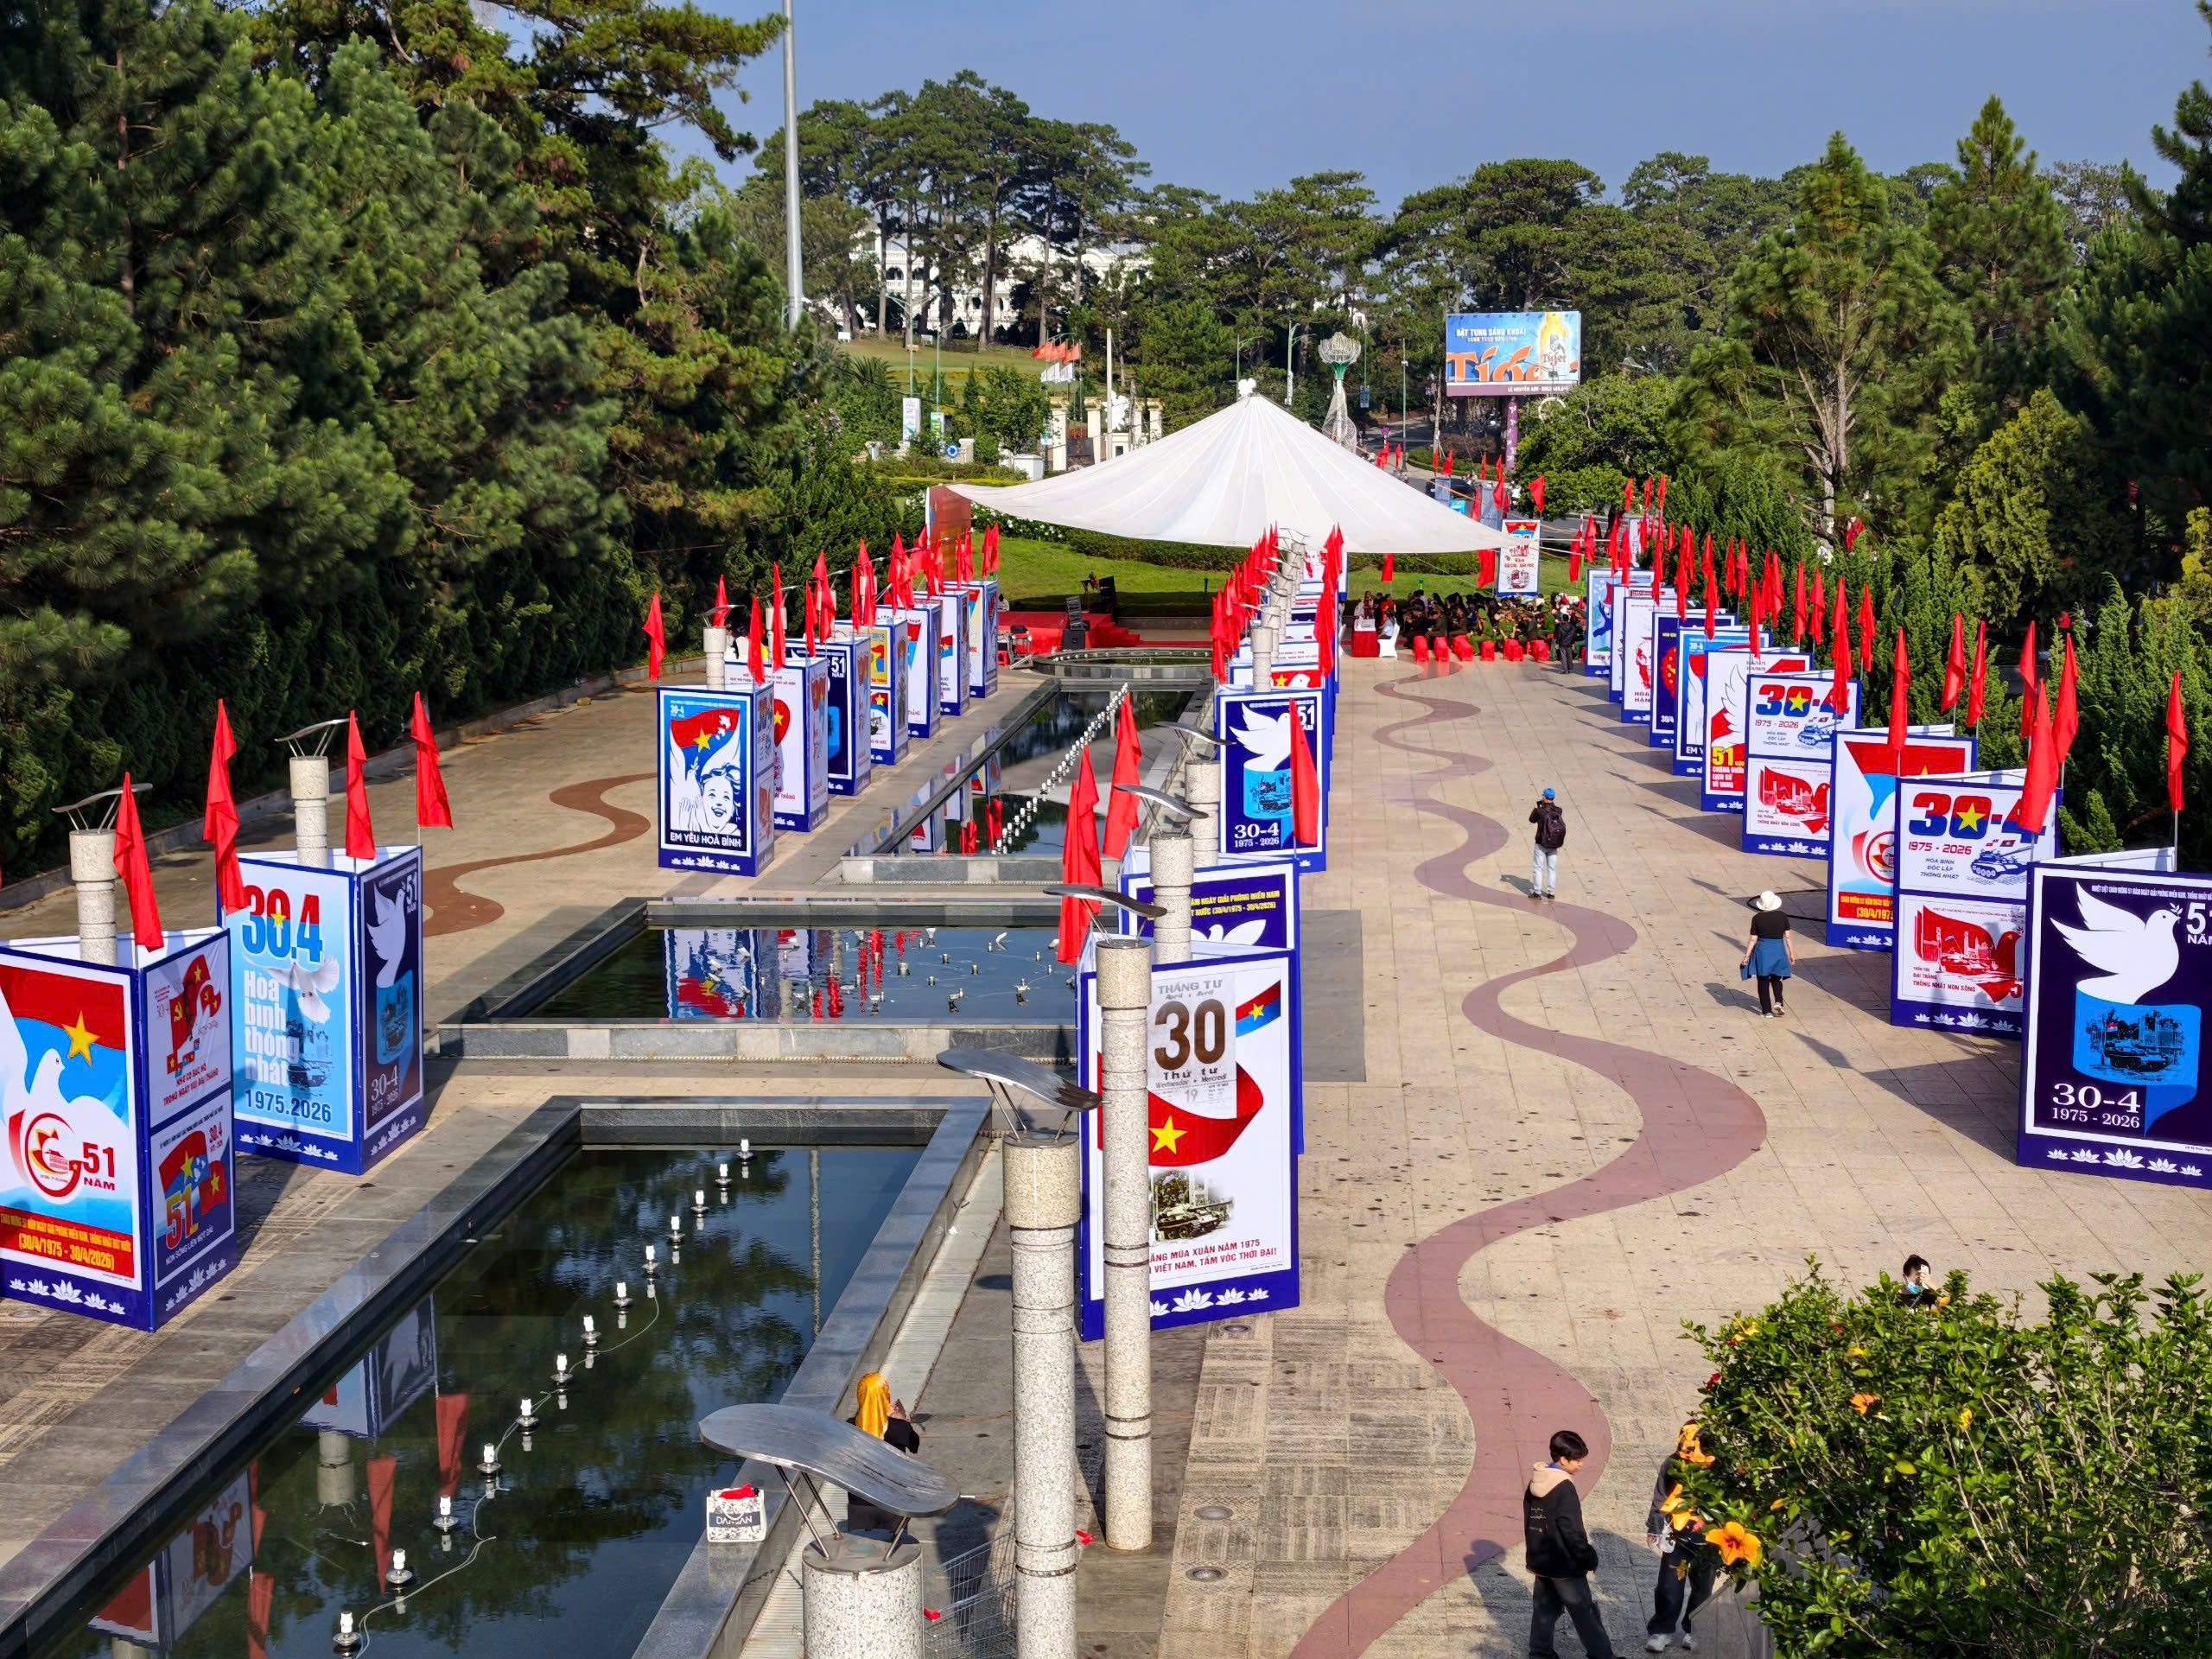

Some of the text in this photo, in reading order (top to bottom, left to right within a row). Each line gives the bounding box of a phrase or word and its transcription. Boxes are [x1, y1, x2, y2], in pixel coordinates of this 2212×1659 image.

[831, 656, 845, 673] 51
[1297, 704, 1315, 726] 51
[1712, 746, 1734, 766] 51
[670, 830, 741, 848] EM YÊU HOÀ BÌNH
[1234, 822, 1280, 839] 30-4
[1234, 839, 1254, 848] 1975
[1260, 837, 1280, 847] 2026
[1908, 841, 1933, 852] 1975
[1942, 843, 1973, 855] 2026
[241, 885, 323, 963] 30.4
[244, 969, 279, 1003] Hòa
[1157, 980, 1223, 994] THÁNG TƯ
[244, 996, 287, 1031] bình
[1154, 999, 1225, 1071] 30
[371, 1065, 398, 1102] 30-4
[1155, 1074, 1227, 1088] Wednesday Mercredi
[1164, 1067, 1217, 1080] Thứ tư
[245, 1089, 332, 1123] 1975.2026
[2052, 1083, 2141, 1114] 30-4
[2052, 1107, 2088, 1122] 1975
[2102, 1113, 2140, 1128] 2026
[82, 1141, 116, 1178] 51
[83, 1176, 116, 1192] NĂM
[18, 1232, 63, 1258] (30/4/1975
[69, 1244, 115, 1271] 30/4/2026)
[1170, 1248, 1190, 1260] MÙA
[1192, 1243, 1216, 1256] XUÂN
[1217, 1242, 1237, 1253] NĂM
[1240, 1238, 1261, 1249] 1975
[1154, 1262, 1172, 1274] VIỆT
[1221, 1250, 1236, 1262] VÓC
[1239, 1249, 1257, 1260] THỜI
[1260, 1247, 1277, 1259] ĐẠI!
